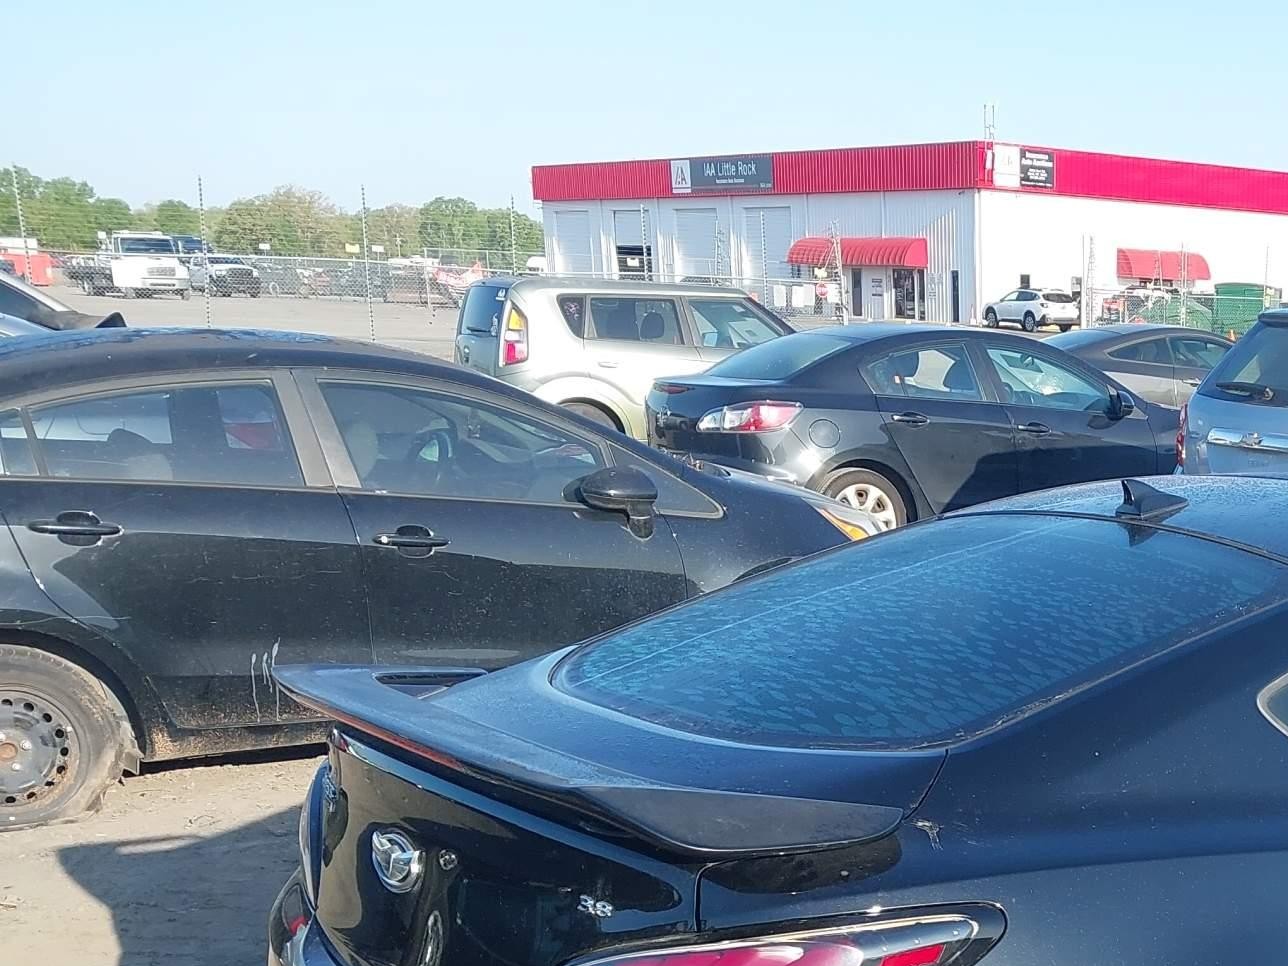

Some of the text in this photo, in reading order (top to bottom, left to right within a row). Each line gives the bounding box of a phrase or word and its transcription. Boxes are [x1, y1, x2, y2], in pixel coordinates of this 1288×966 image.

[703, 160, 757, 177] IAA Little Rock
